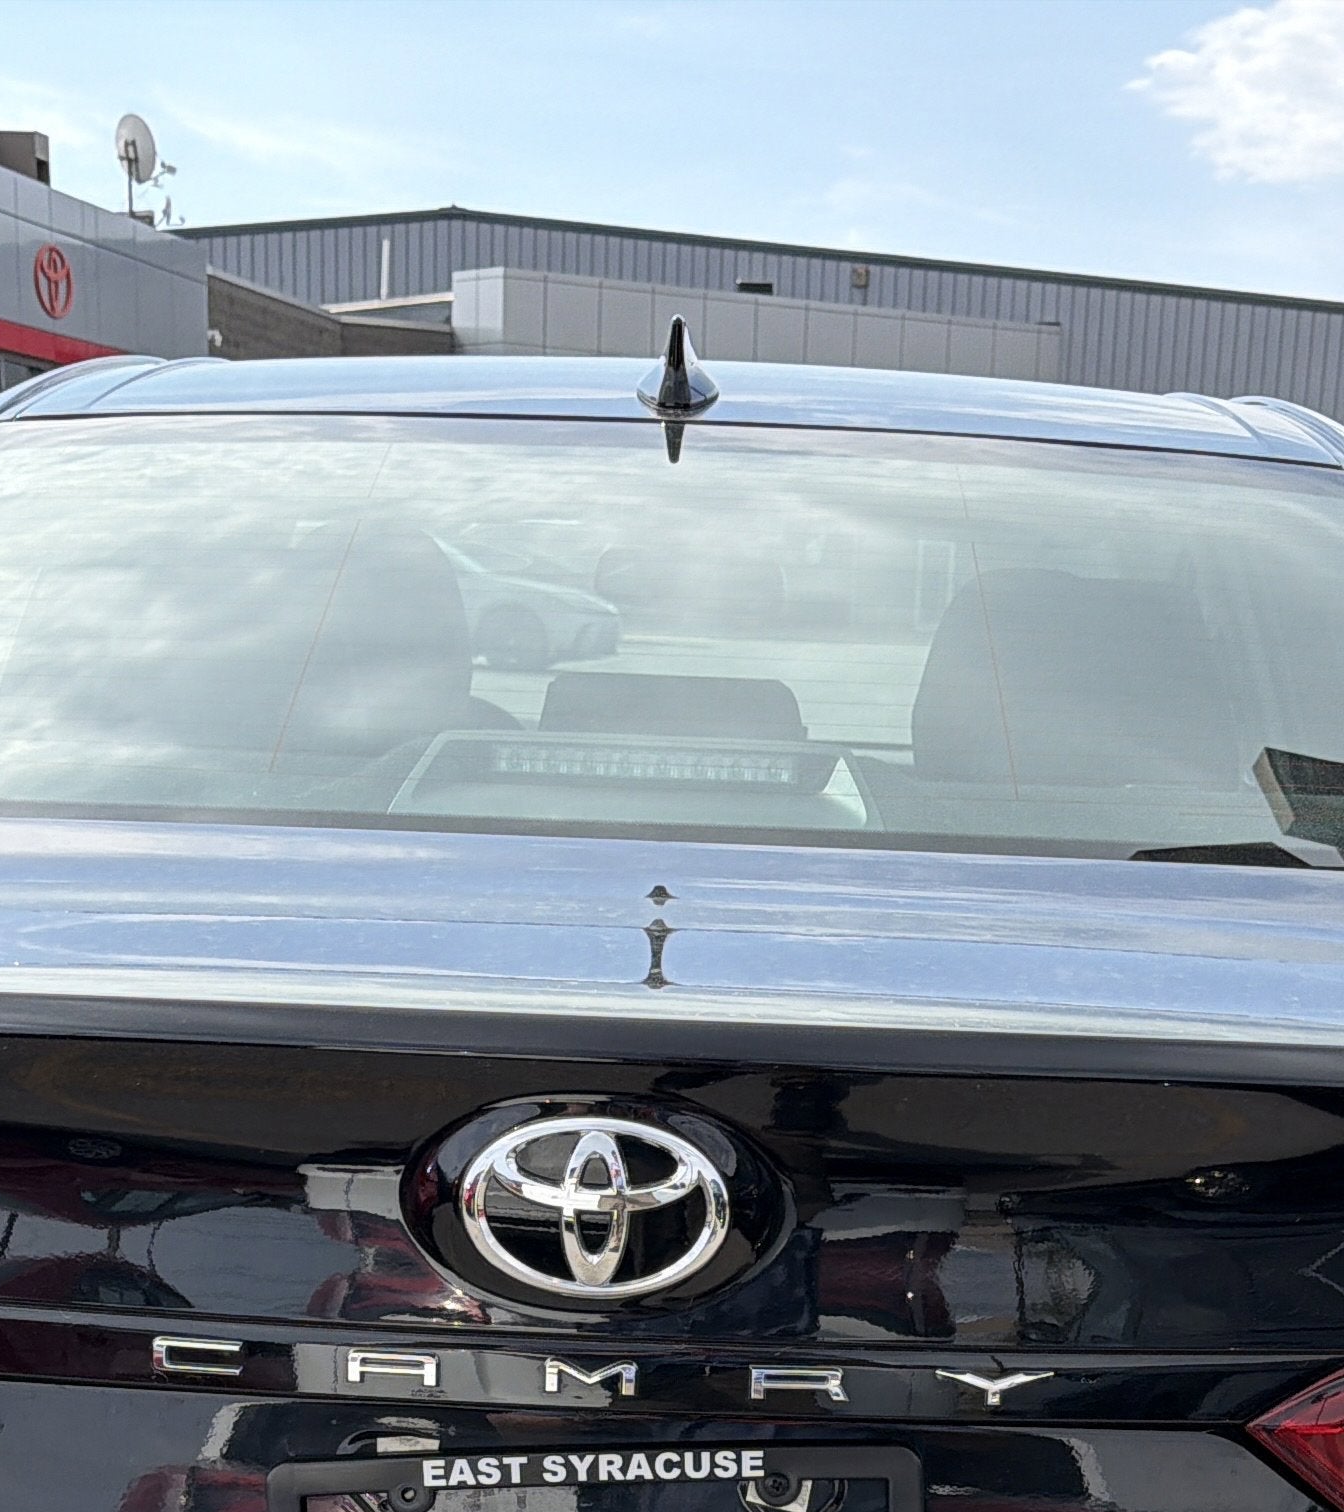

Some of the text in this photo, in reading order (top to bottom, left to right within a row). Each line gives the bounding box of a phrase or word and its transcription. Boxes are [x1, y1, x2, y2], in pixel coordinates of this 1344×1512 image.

[152, 1335, 1056, 1407] CAMRY
[422, 1450, 766, 1487] EAST SYRACUSE
